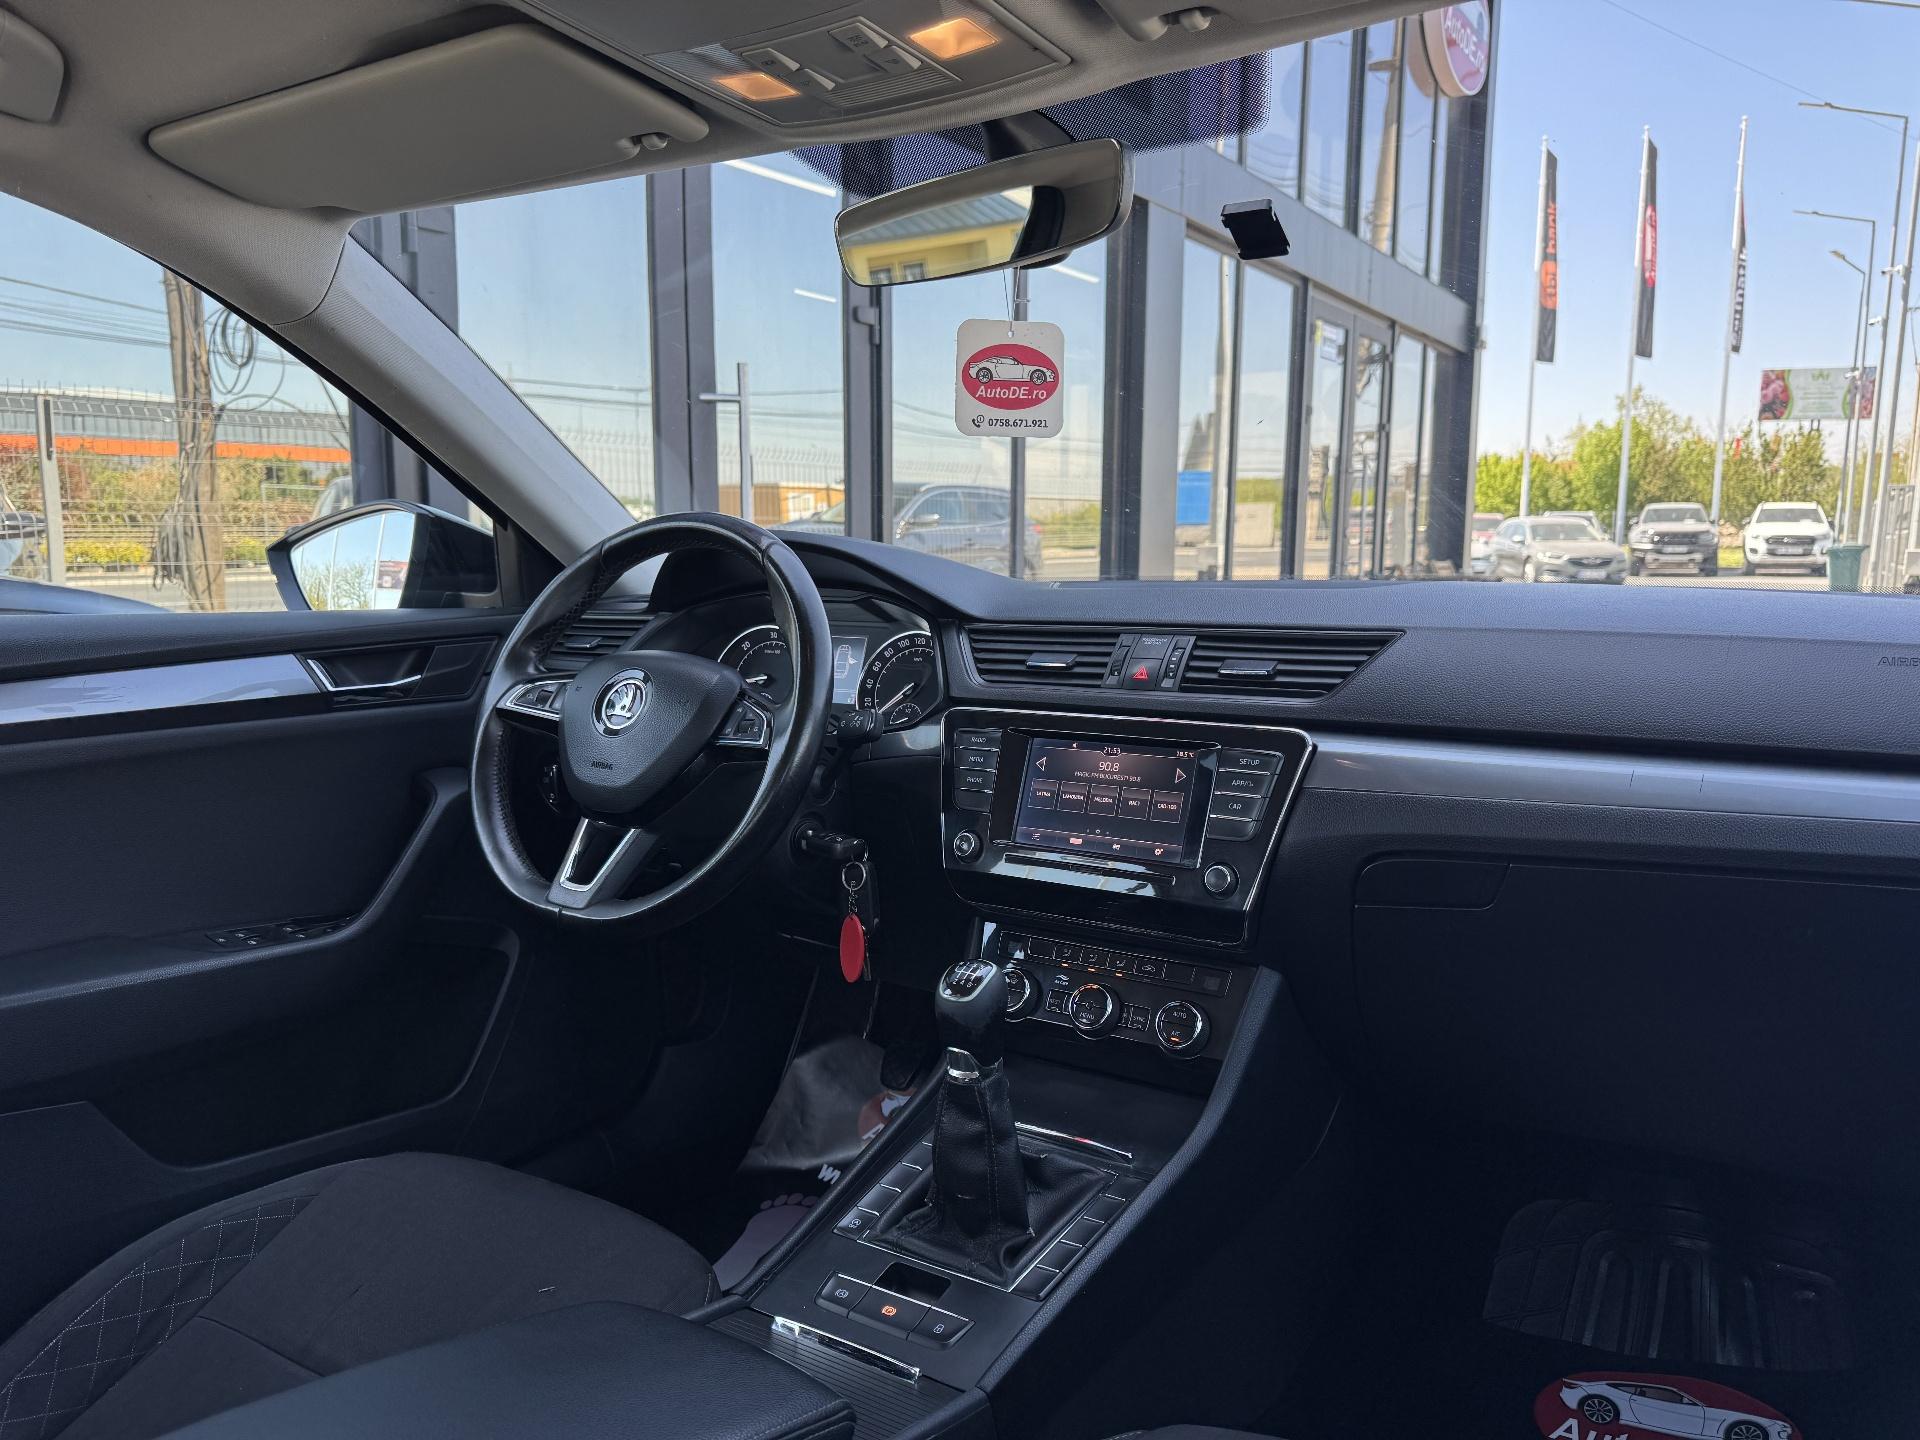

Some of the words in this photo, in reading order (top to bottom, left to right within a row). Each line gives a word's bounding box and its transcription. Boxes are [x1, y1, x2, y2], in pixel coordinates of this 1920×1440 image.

[976, 386, 1047, 399] AutoDE.ro
[988, 418, 1048, 428] 0758.671.921
[770, 631, 778, 639] 30
[741, 641, 751, 651] 20
[897, 639, 910, 649] 100
[914, 637, 926, 645] 120
[883, 647, 894, 658] 80
[872, 661, 882, 672] 60
[865, 678, 874, 689] 40
[864, 697, 872, 707] 20
[1099, 761, 1120, 772] 90.8
[1239, 758, 1260, 766] SETUP
[1228, 802, 1242, 810] CAR
[1079, 1011, 1095, 1020] MENU
[1173, 1011, 1187, 1019] AUTO
